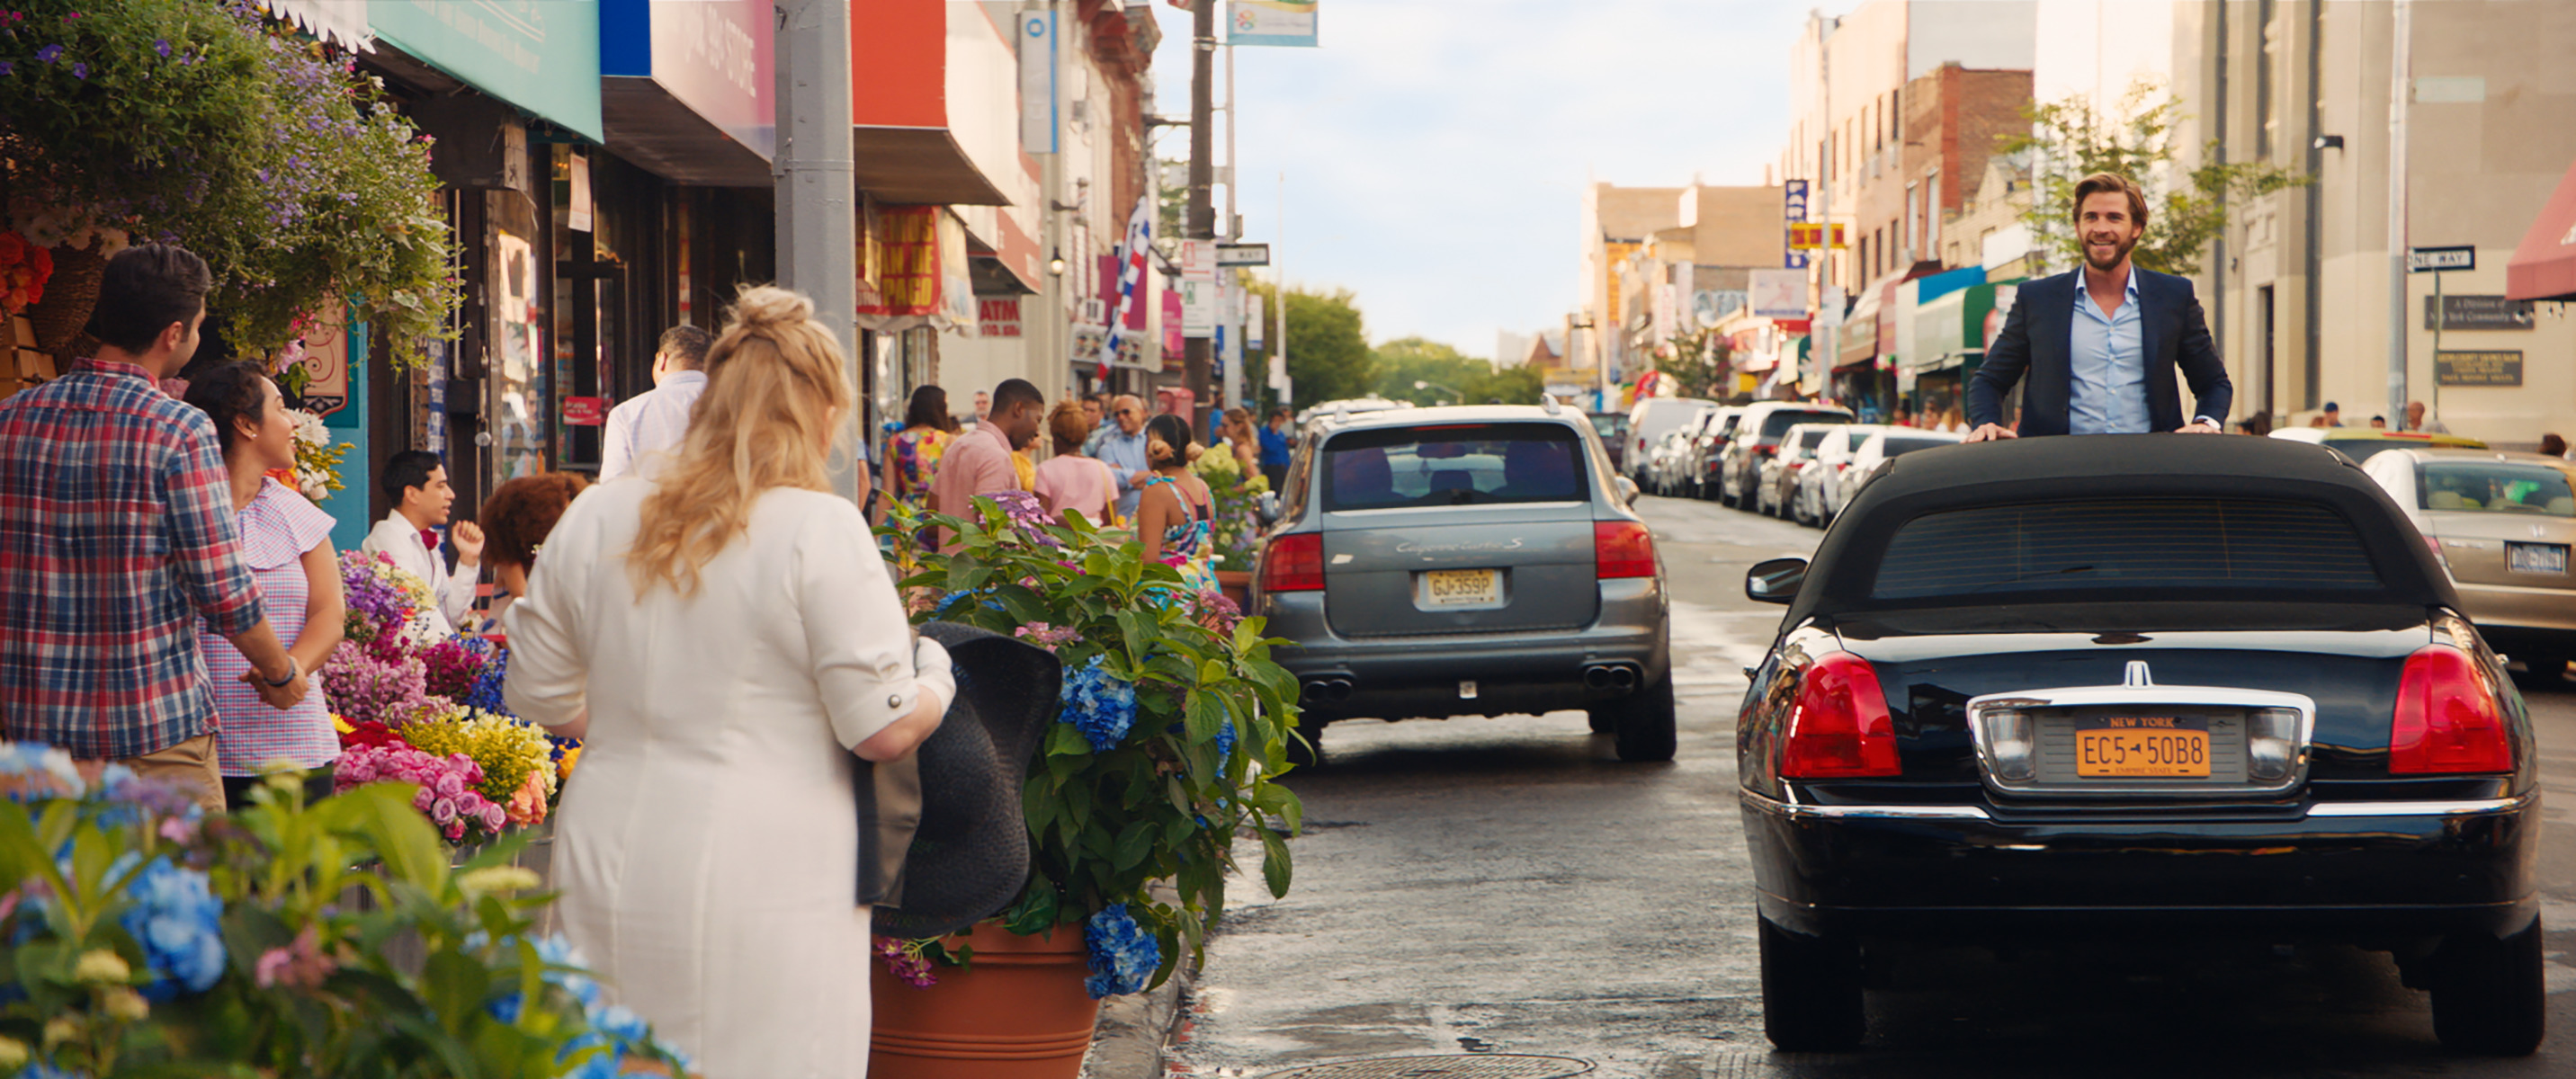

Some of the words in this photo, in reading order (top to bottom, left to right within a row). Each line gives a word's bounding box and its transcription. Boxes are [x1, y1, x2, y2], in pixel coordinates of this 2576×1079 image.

[912, 245, 934, 274] DE
[2437, 252, 2464, 264] WAY
[882, 277, 933, 306] PAGO
[979, 299, 1021, 321] ATM
[1503, 538, 1523, 549] S
[2110, 718, 2137, 727] NEW
[2141, 718, 2175, 727] YORK
